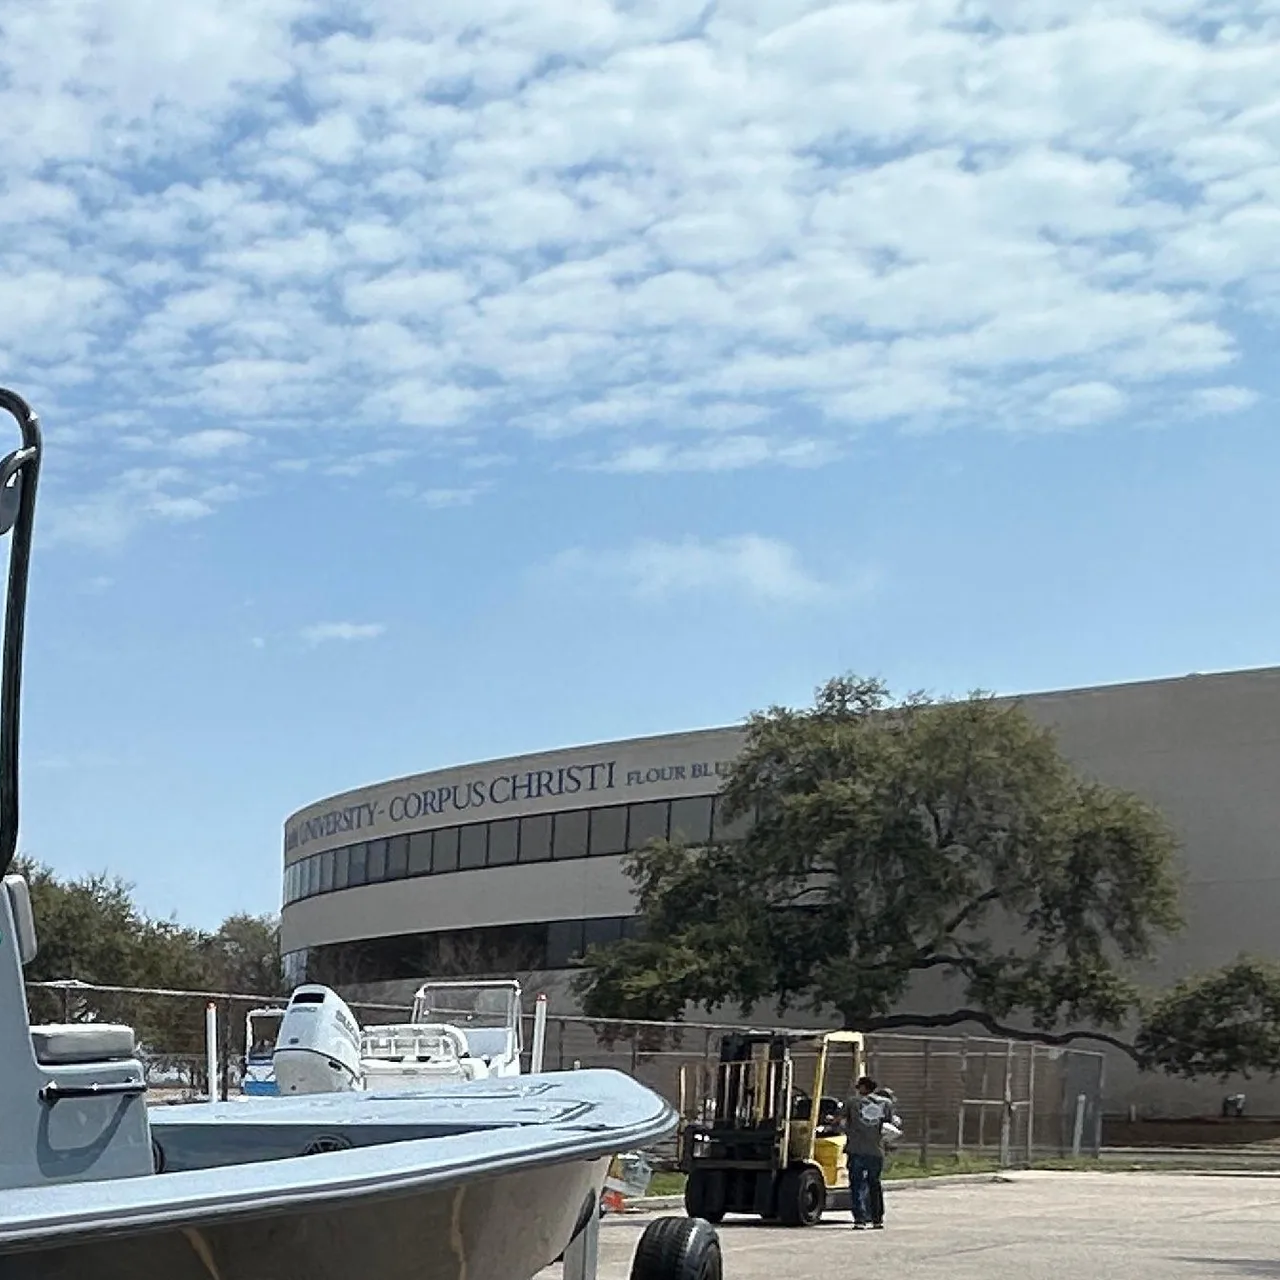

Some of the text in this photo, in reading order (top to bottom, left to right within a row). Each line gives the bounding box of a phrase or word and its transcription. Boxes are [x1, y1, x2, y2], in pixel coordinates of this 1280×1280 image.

[391, 780, 486, 822] CORPUS
[489, 761, 617, 804] CHRISTI
[625, 765, 686, 786] FLOUR
